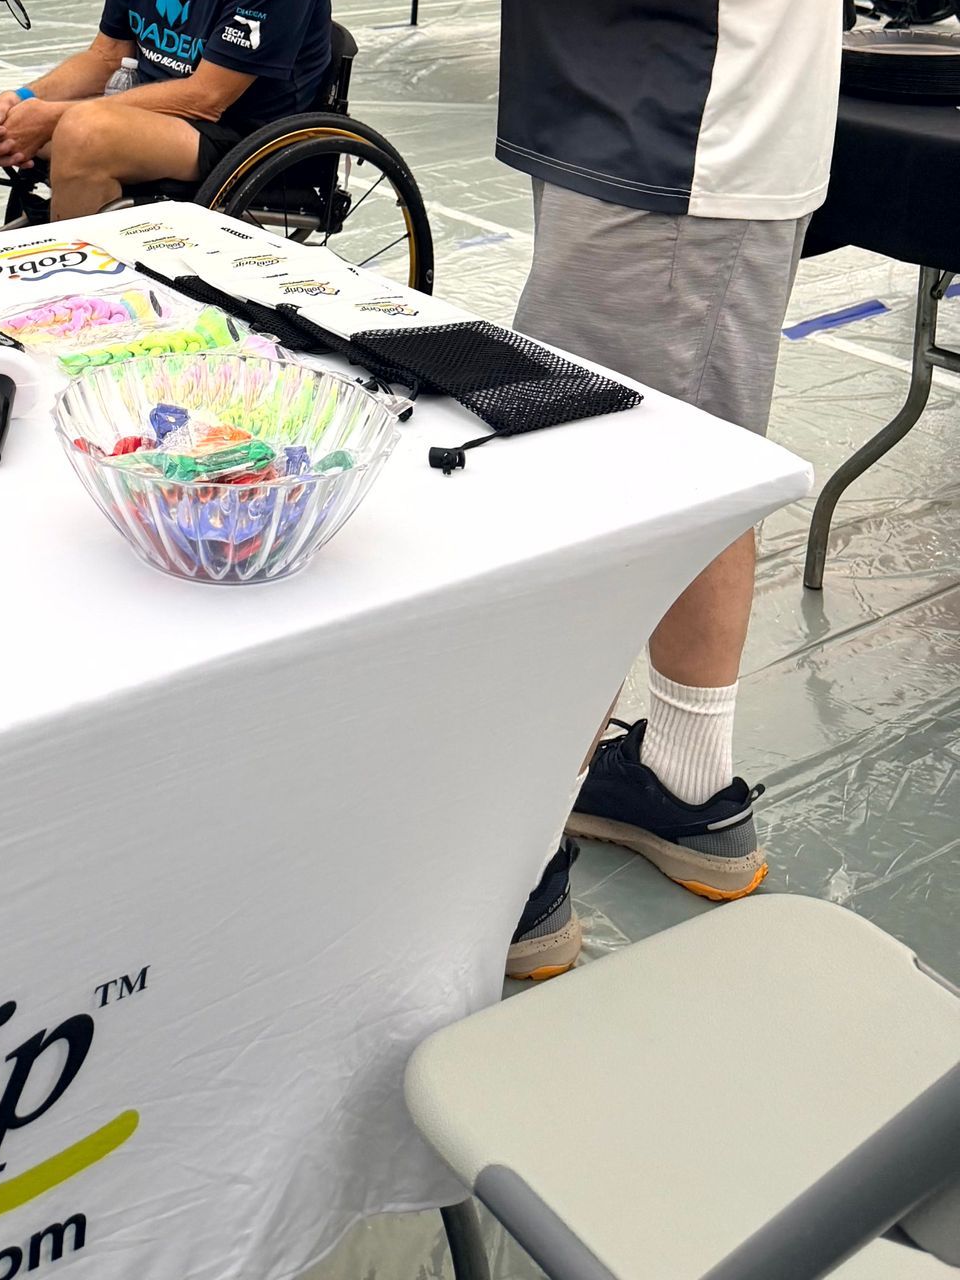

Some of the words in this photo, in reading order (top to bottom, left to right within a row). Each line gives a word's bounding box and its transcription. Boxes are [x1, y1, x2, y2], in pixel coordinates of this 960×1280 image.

[236, 7, 267, 19] DIADEM
[224, 26, 245, 38] TECH
[221, 33, 251, 48] CENTER
